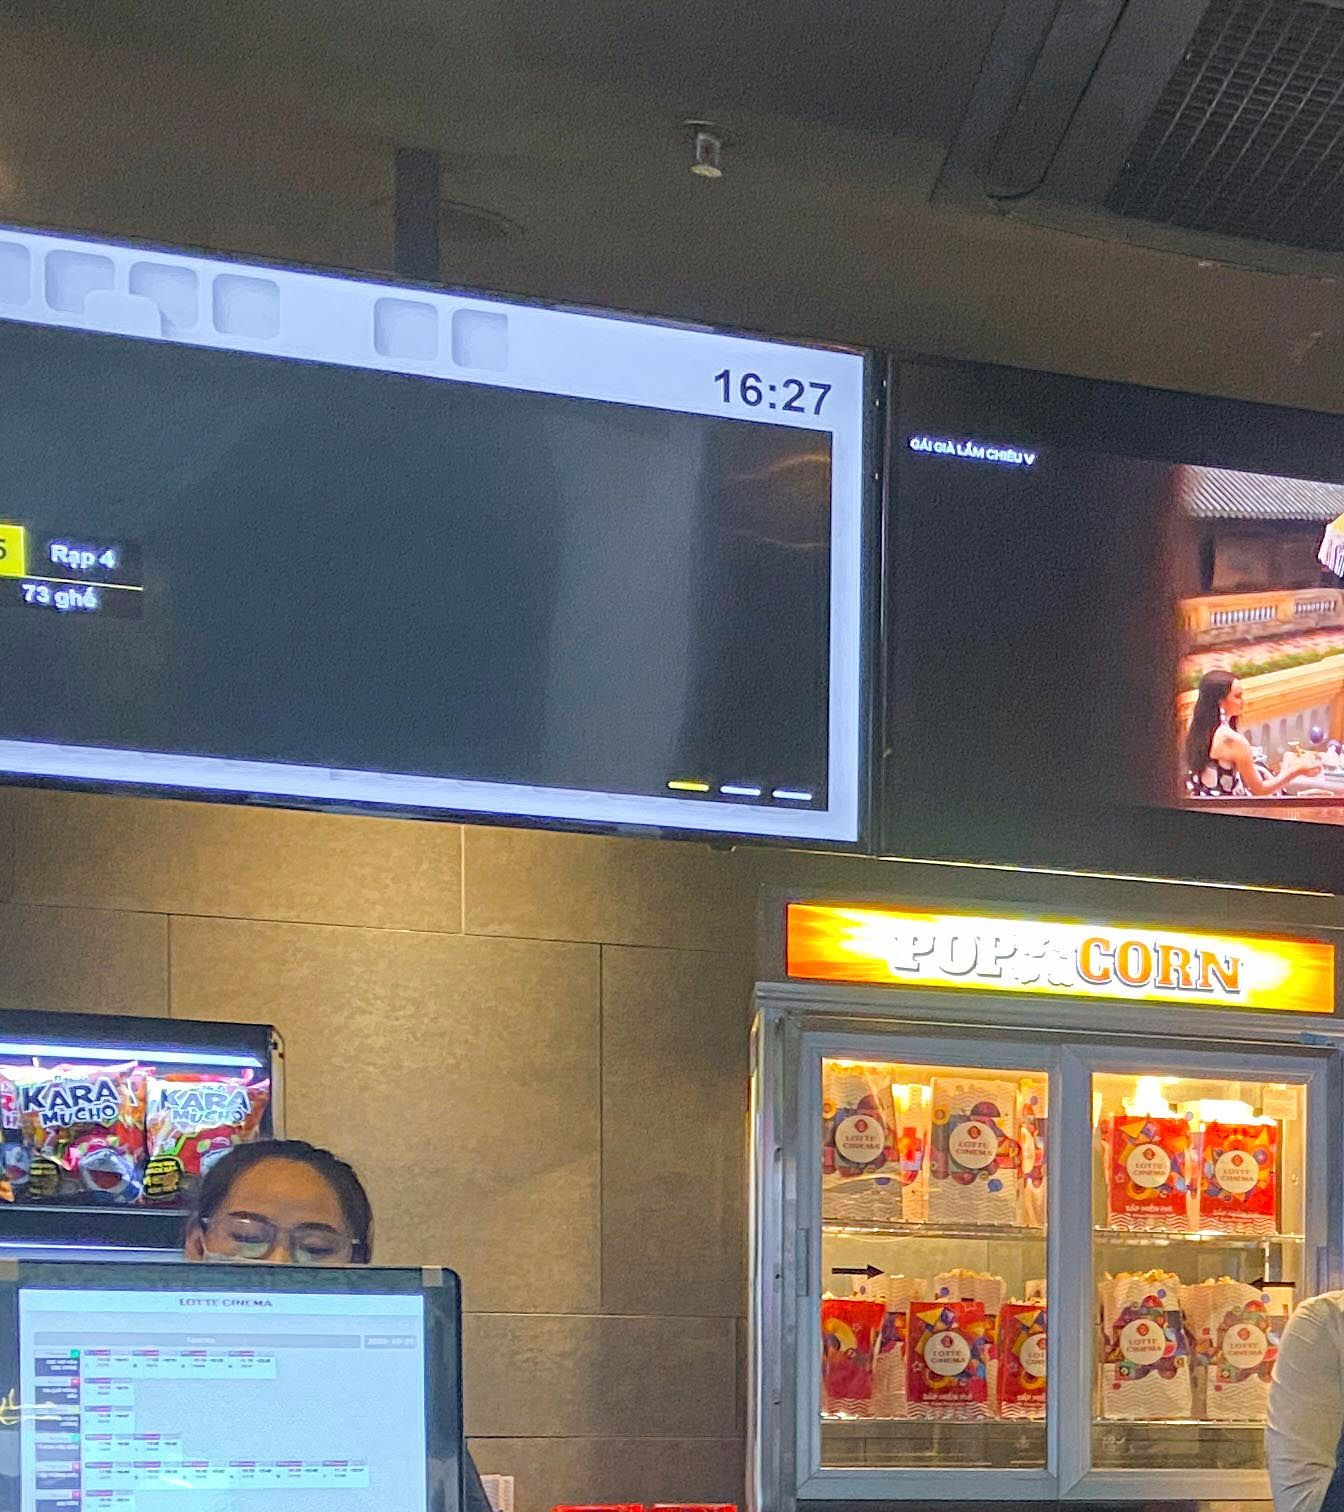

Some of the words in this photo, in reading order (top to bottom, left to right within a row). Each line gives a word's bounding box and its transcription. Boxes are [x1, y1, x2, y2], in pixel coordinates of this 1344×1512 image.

[714, 369, 832, 415] 16:27
[98, 549, 116, 569] 4
[22, 584, 50, 603] 73
[22, 1079, 119, 1111] KARA
[160, 1088, 249, 1111] KARA
[42, 1104, 116, 1126] MUCHO
[173, 1109, 244, 1124] MUCHO
